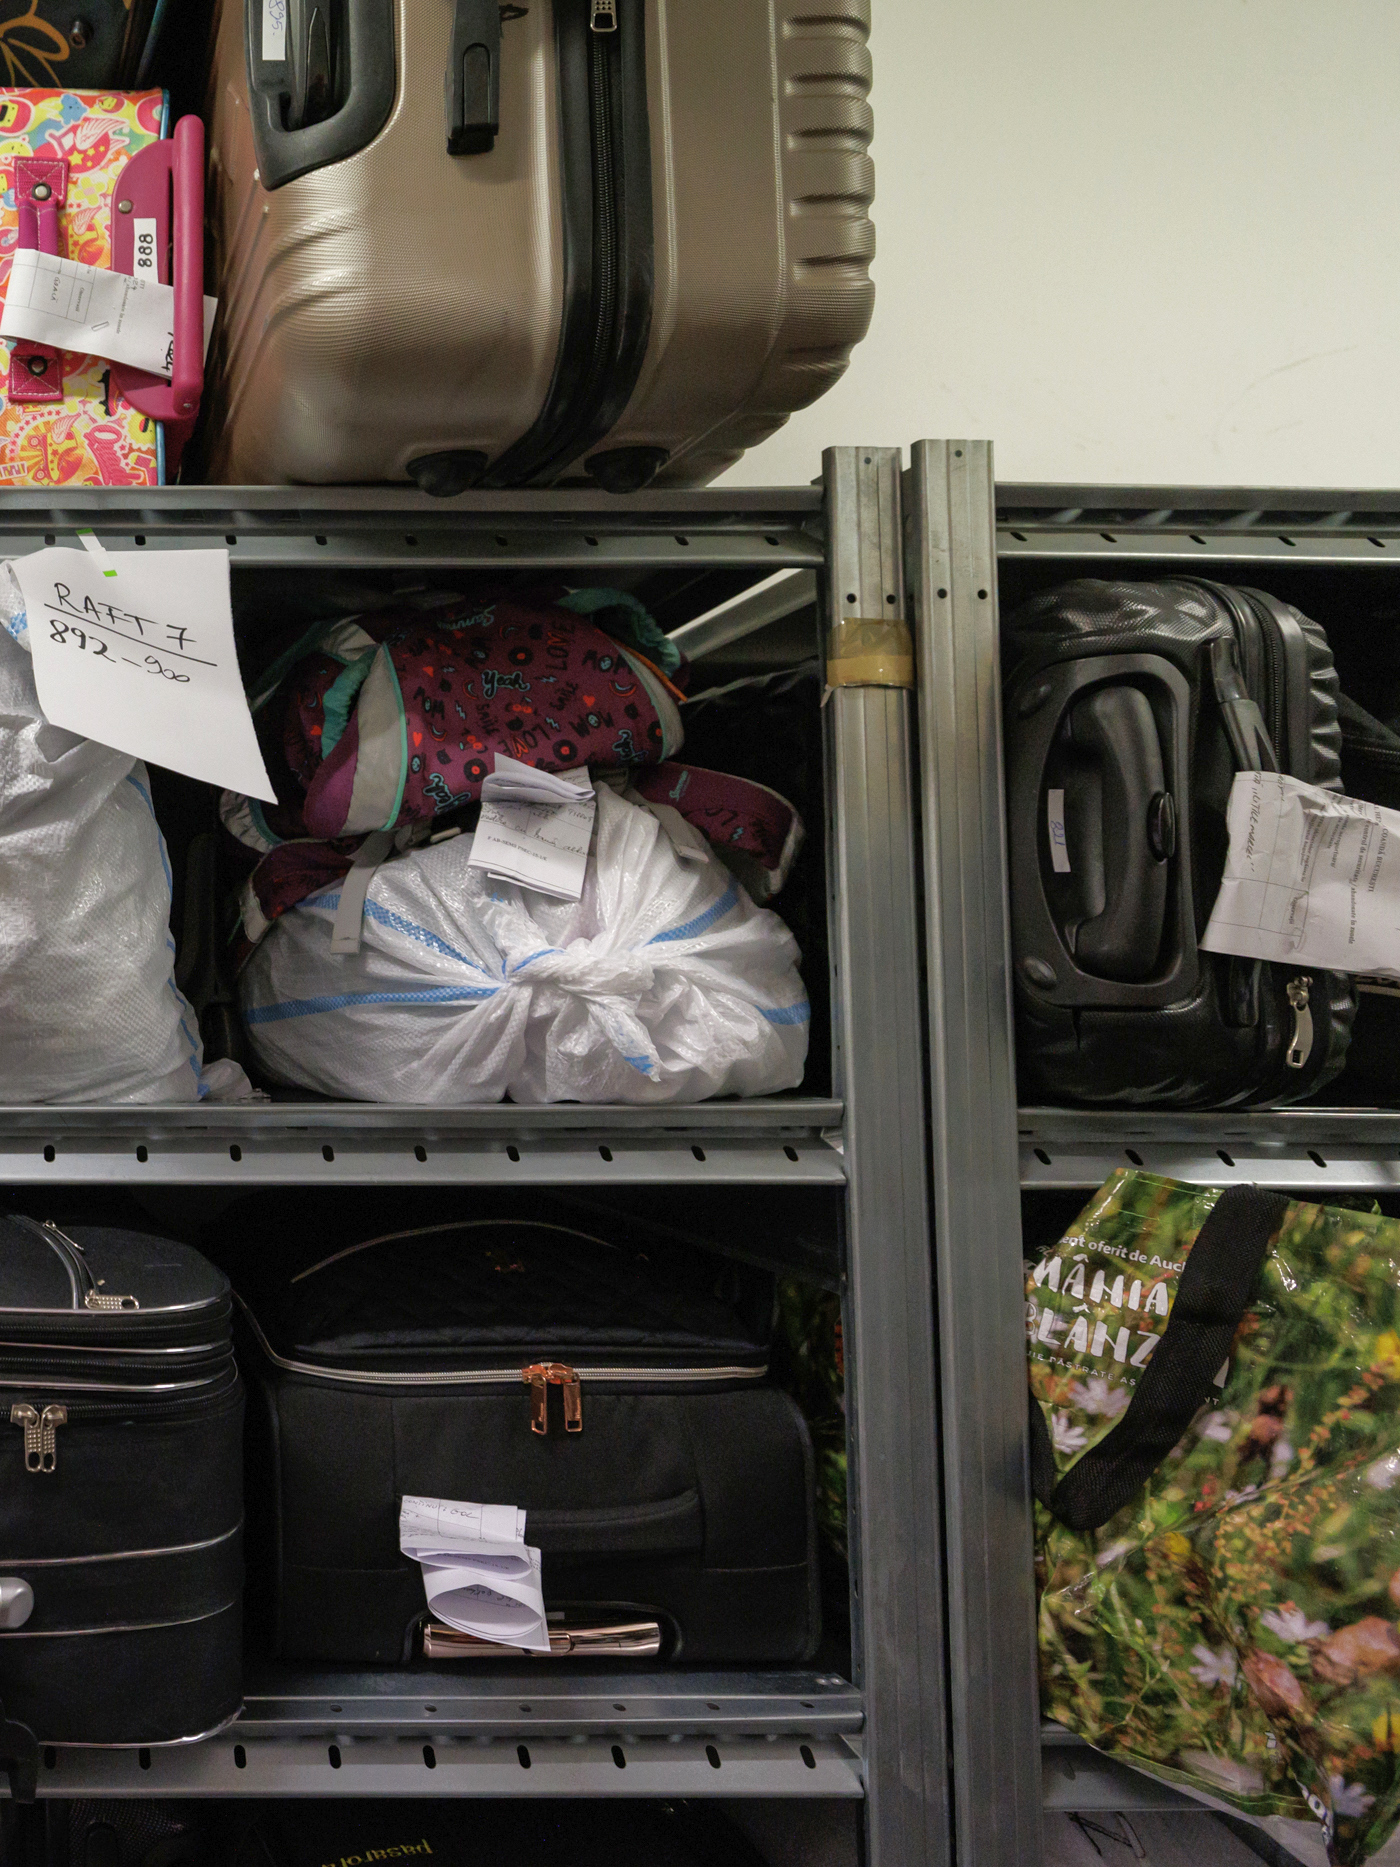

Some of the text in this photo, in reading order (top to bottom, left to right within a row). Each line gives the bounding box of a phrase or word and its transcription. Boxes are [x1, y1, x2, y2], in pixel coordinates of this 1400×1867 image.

[138, 233, 154, 268] 888
[54, 582, 197, 650] RAFT 7
[1088, 1241, 1128, 1259] oferit
[1129, 1250, 1148, 1264] de
[322, 1839, 433, 1867] pasarol
